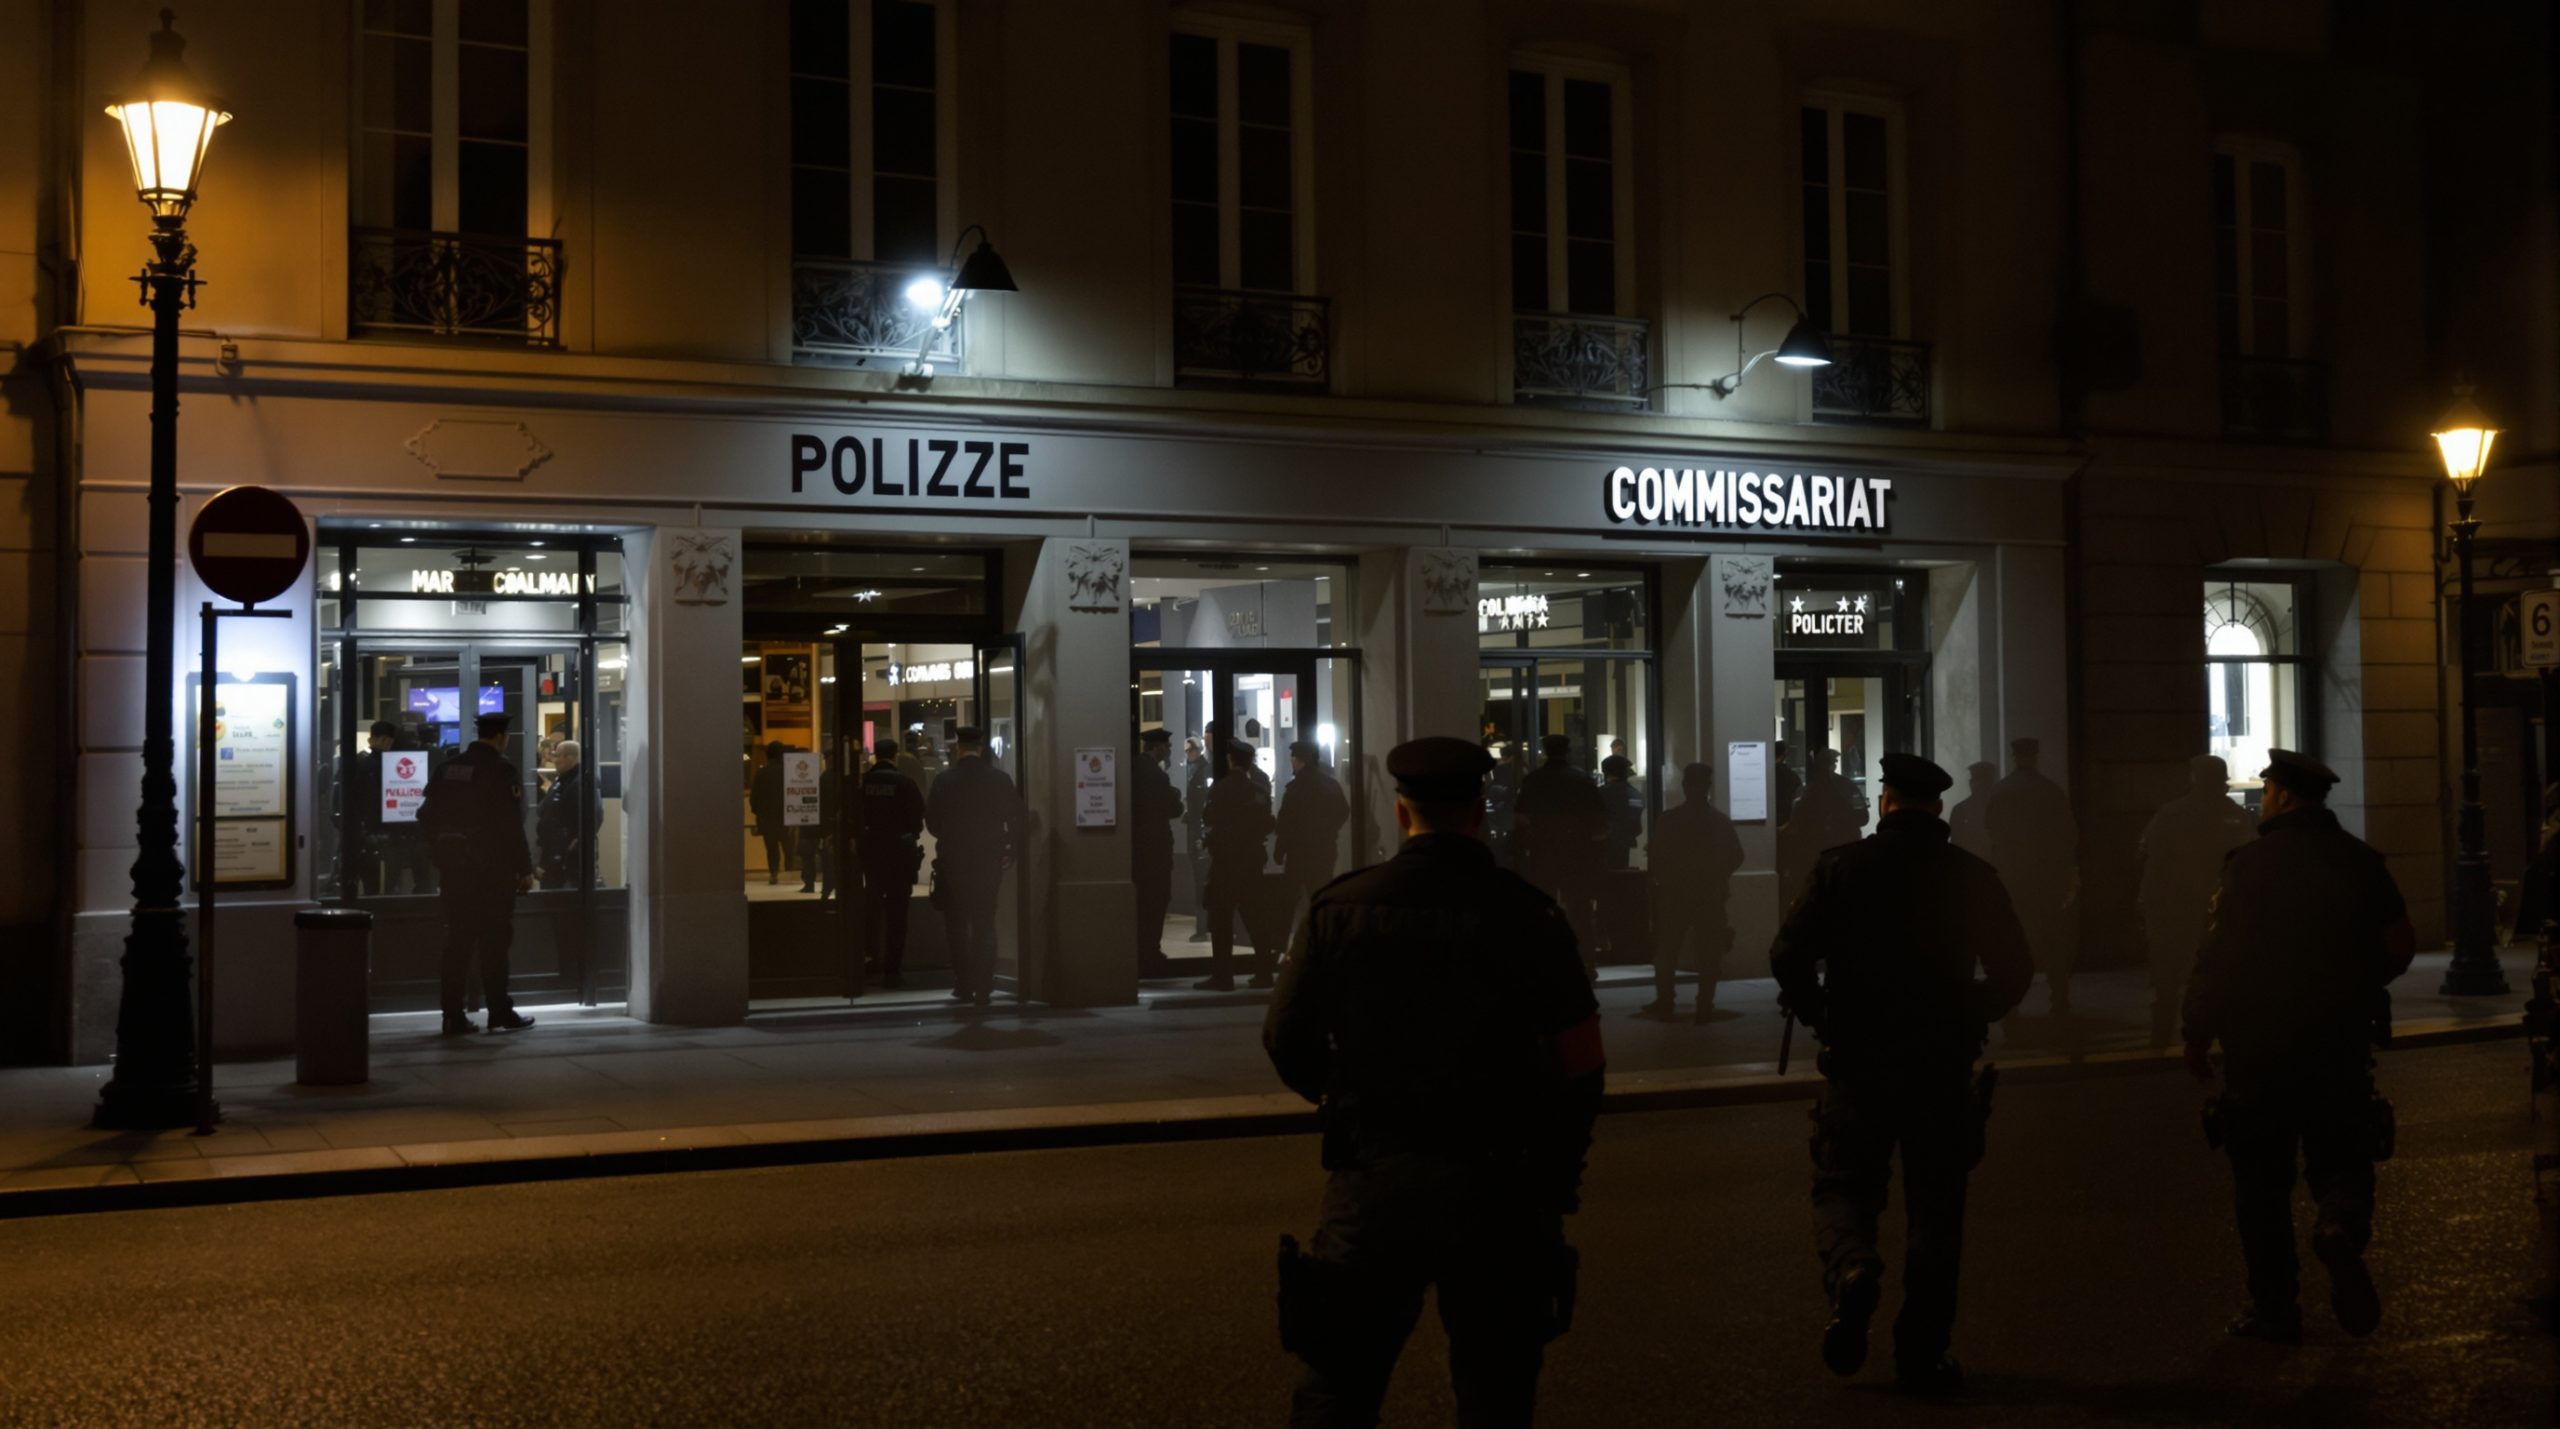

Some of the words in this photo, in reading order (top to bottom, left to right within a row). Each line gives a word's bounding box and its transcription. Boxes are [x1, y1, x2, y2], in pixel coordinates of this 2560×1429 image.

[791, 434, 1030, 499] POLIZZE
[1610, 466, 1892, 529] COMMISSARIAT
[1792, 613, 1865, 635] POLICTER
[2532, 602, 2551, 636] 6
